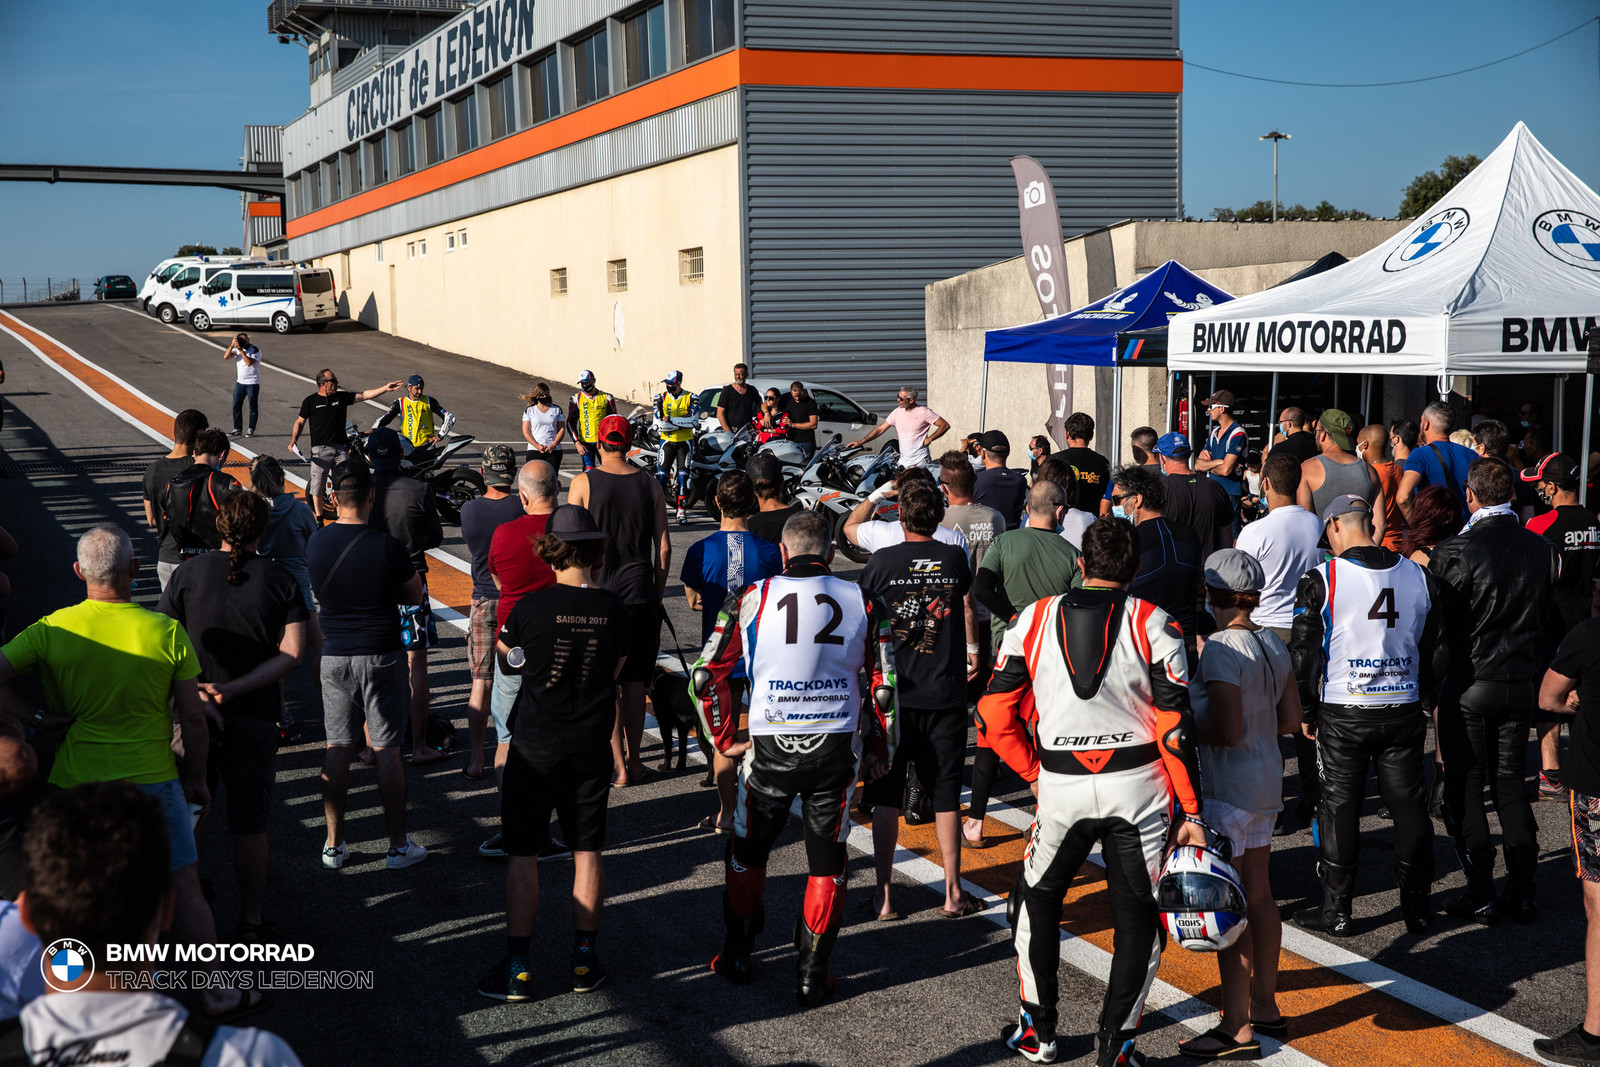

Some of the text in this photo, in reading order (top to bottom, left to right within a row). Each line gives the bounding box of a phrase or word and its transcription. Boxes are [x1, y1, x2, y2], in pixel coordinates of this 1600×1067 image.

[347, 0, 535, 142] CIRCUIT de LEDENON
[1421, 211, 1466, 232] BMW
[1538, 213, 1600, 232] BMW
[1193, 319, 1407, 353] BMW MOTORRAD
[969, 530, 994, 541] OVER
[912, 559, 942, 572] TT
[889, 578, 920, 586] ROAD
[1368, 588, 1399, 628] 4
[556, 615, 608, 625] SAISON 2017
[777, 592, 844, 645] 12
[1348, 657, 1411, 668] TRACKDAYS
[768, 678, 848, 691] TRACKDAYS
[1366, 683, 1414, 692] MICHELIN
[802, 694, 850, 703] MOTORRAD
[786, 711, 850, 720] MICHELIN
[1053, 732, 1134, 746] DAINESE
[1178, 919, 1201, 927] SHOEI
